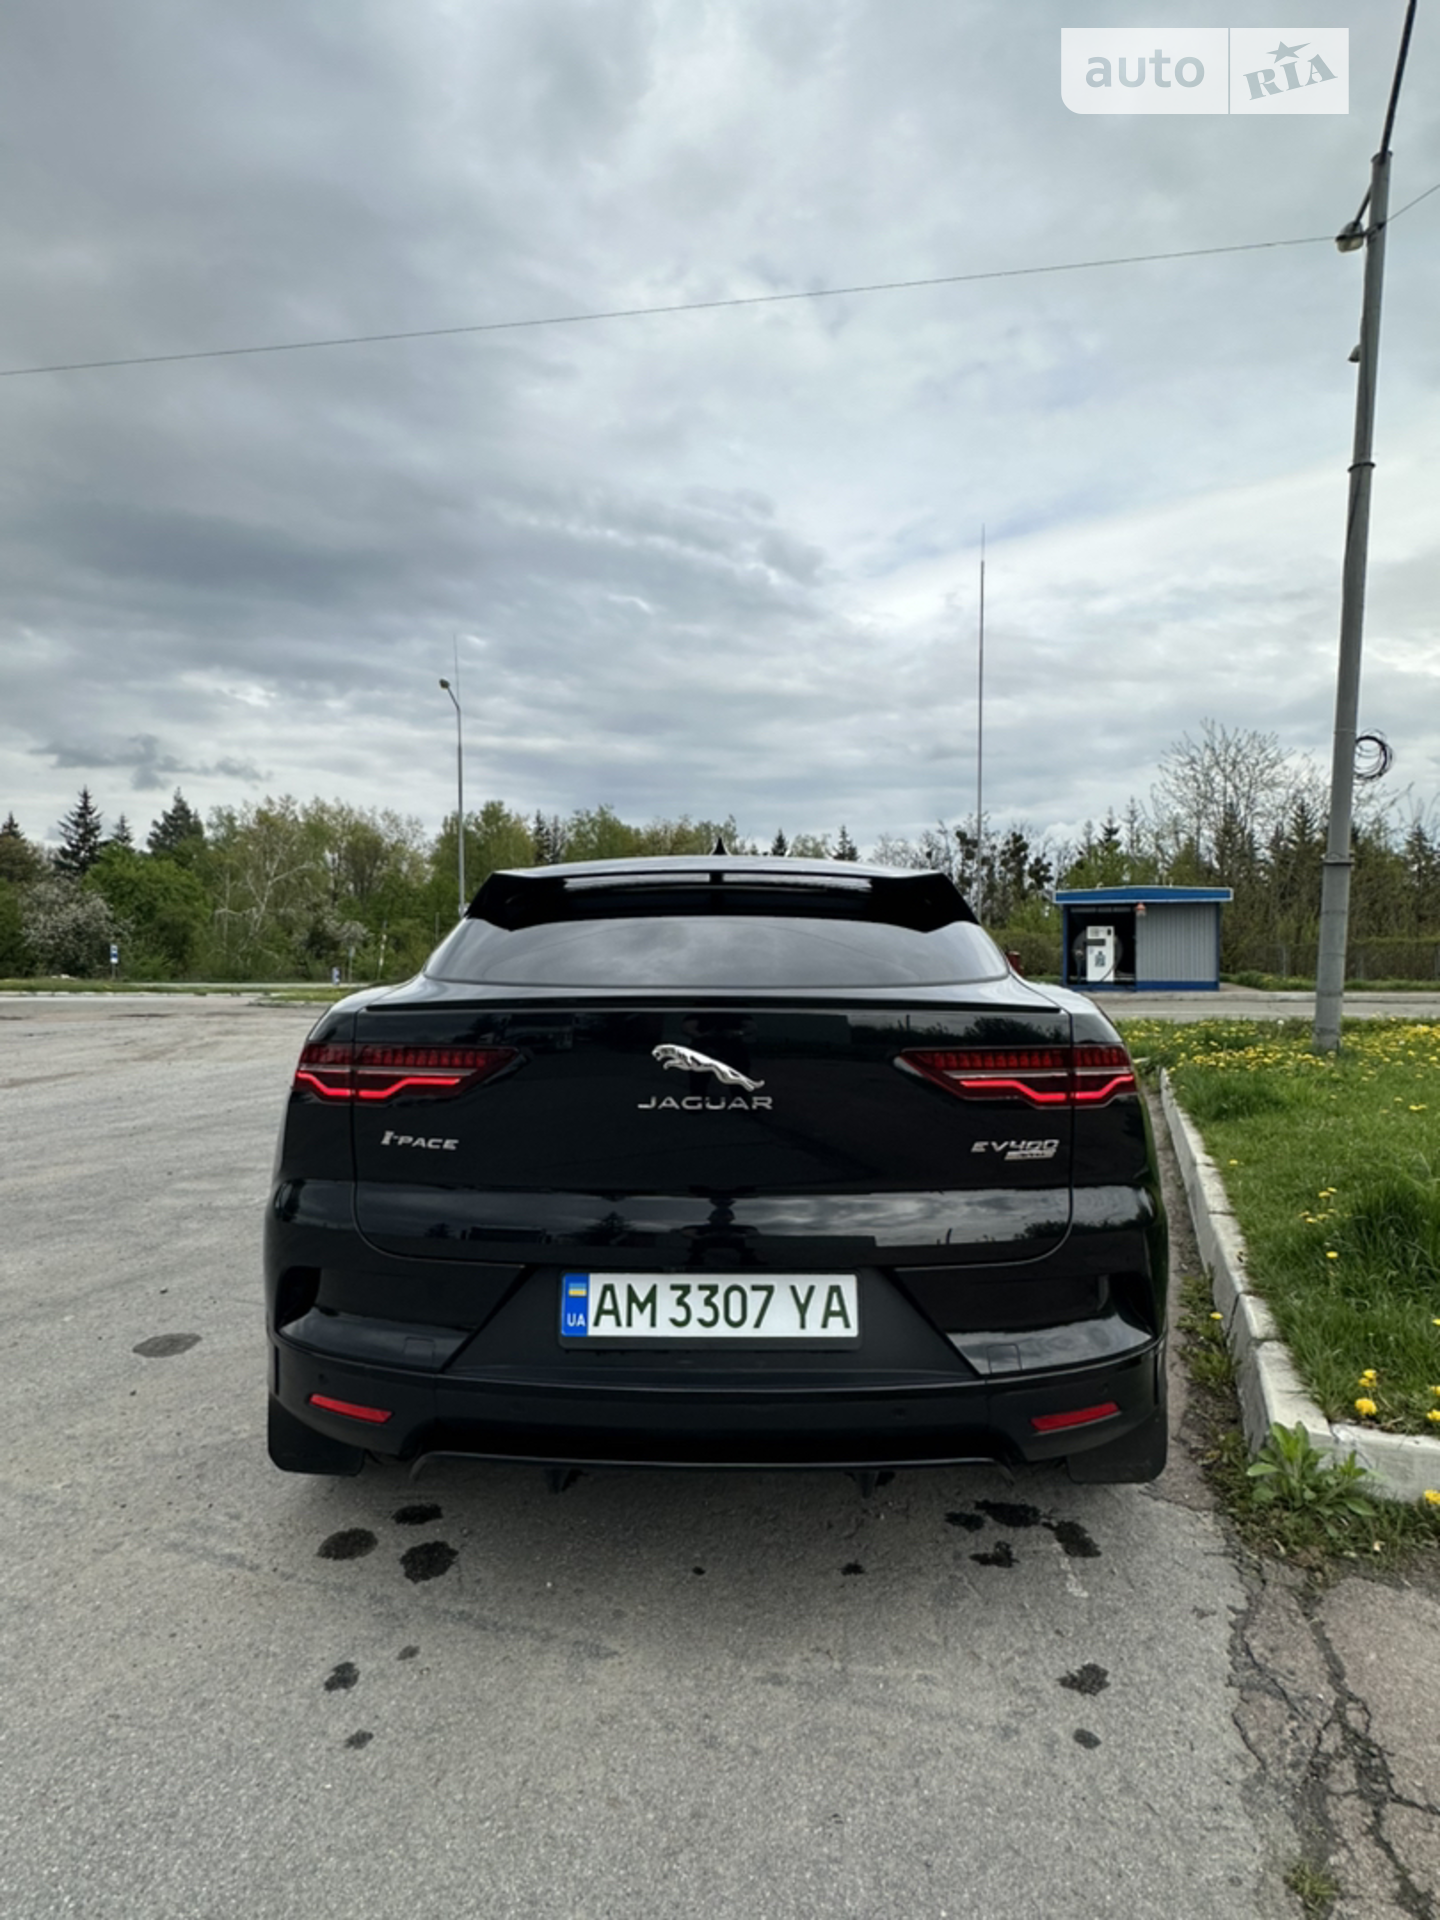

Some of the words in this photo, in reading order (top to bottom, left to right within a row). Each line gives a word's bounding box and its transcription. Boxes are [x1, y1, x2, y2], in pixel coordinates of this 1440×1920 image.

[637, 1096, 773, 1110] JAGUAR
[593, 1283, 658, 1328] AM
[668, 1283, 775, 1329] 3307
[789, 1284, 852, 1330] YA
[566, 1312, 586, 1327] UA
